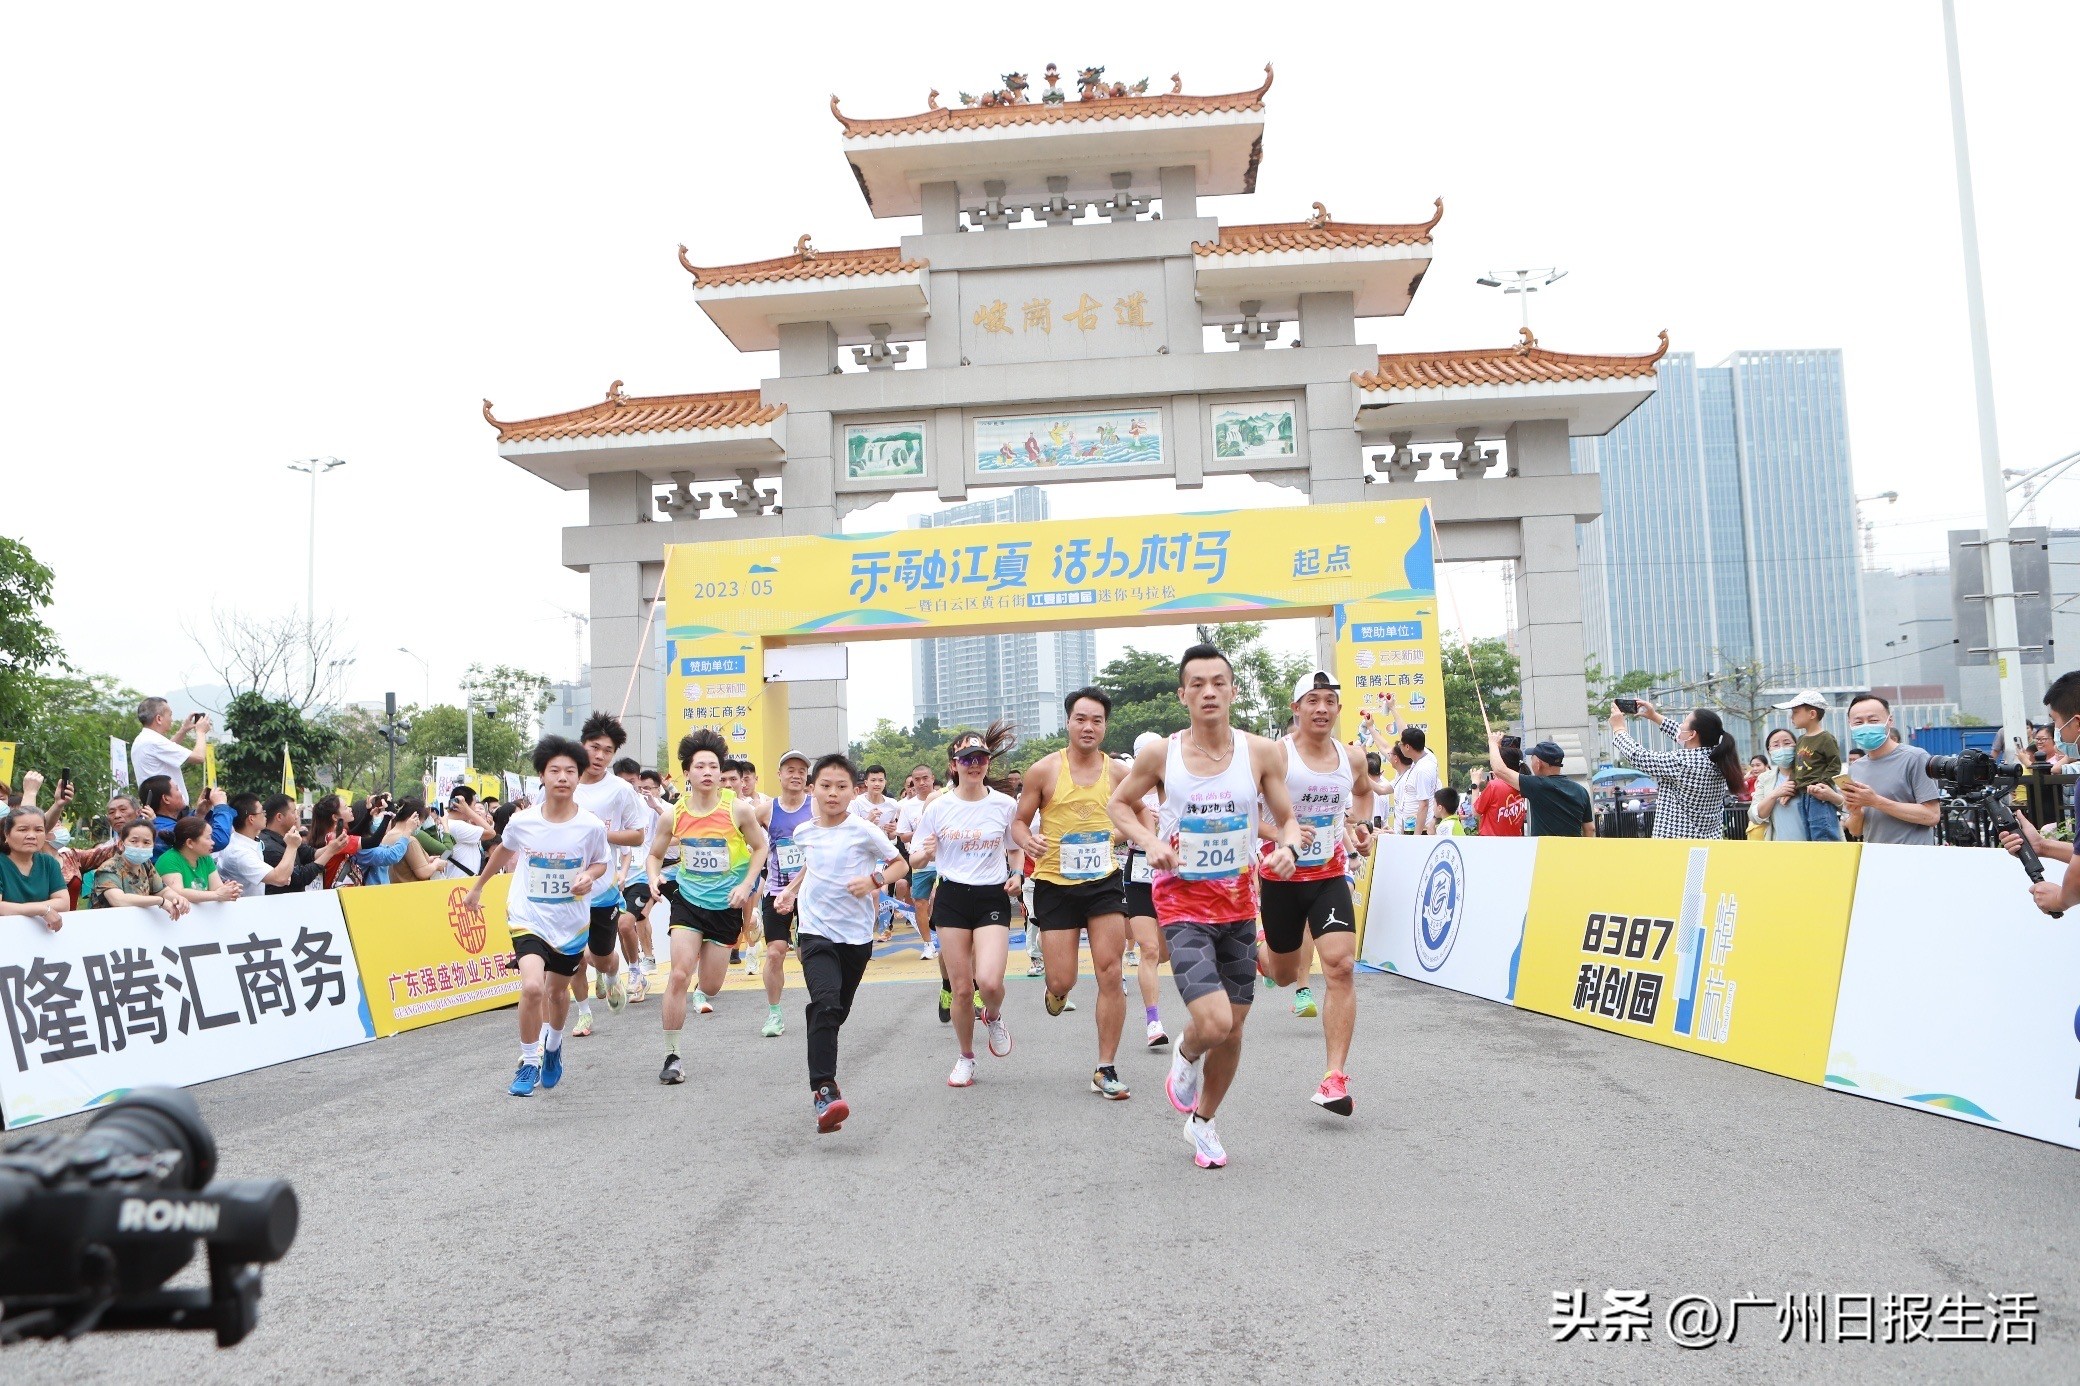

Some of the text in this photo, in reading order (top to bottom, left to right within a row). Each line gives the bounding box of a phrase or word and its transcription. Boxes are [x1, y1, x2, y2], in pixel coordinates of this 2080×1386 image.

[1292, 544, 1352, 577] 起点
[1355, 673, 1424, 687] 隆腾汇商务
[683, 706, 747, 719] 隆腾汇商务
[692, 857, 718, 868] 290
[1074, 855, 1101, 869] 170
[1197, 848, 1235, 867] 204
[541, 881, 571, 894] 135
[1582, 913, 1675, 961] 8387
[0, 925, 348, 1073] 隆腾汇商务
[1574, 964, 1664, 1025] 科创园
[118, 1199, 220, 1232] RONIN
